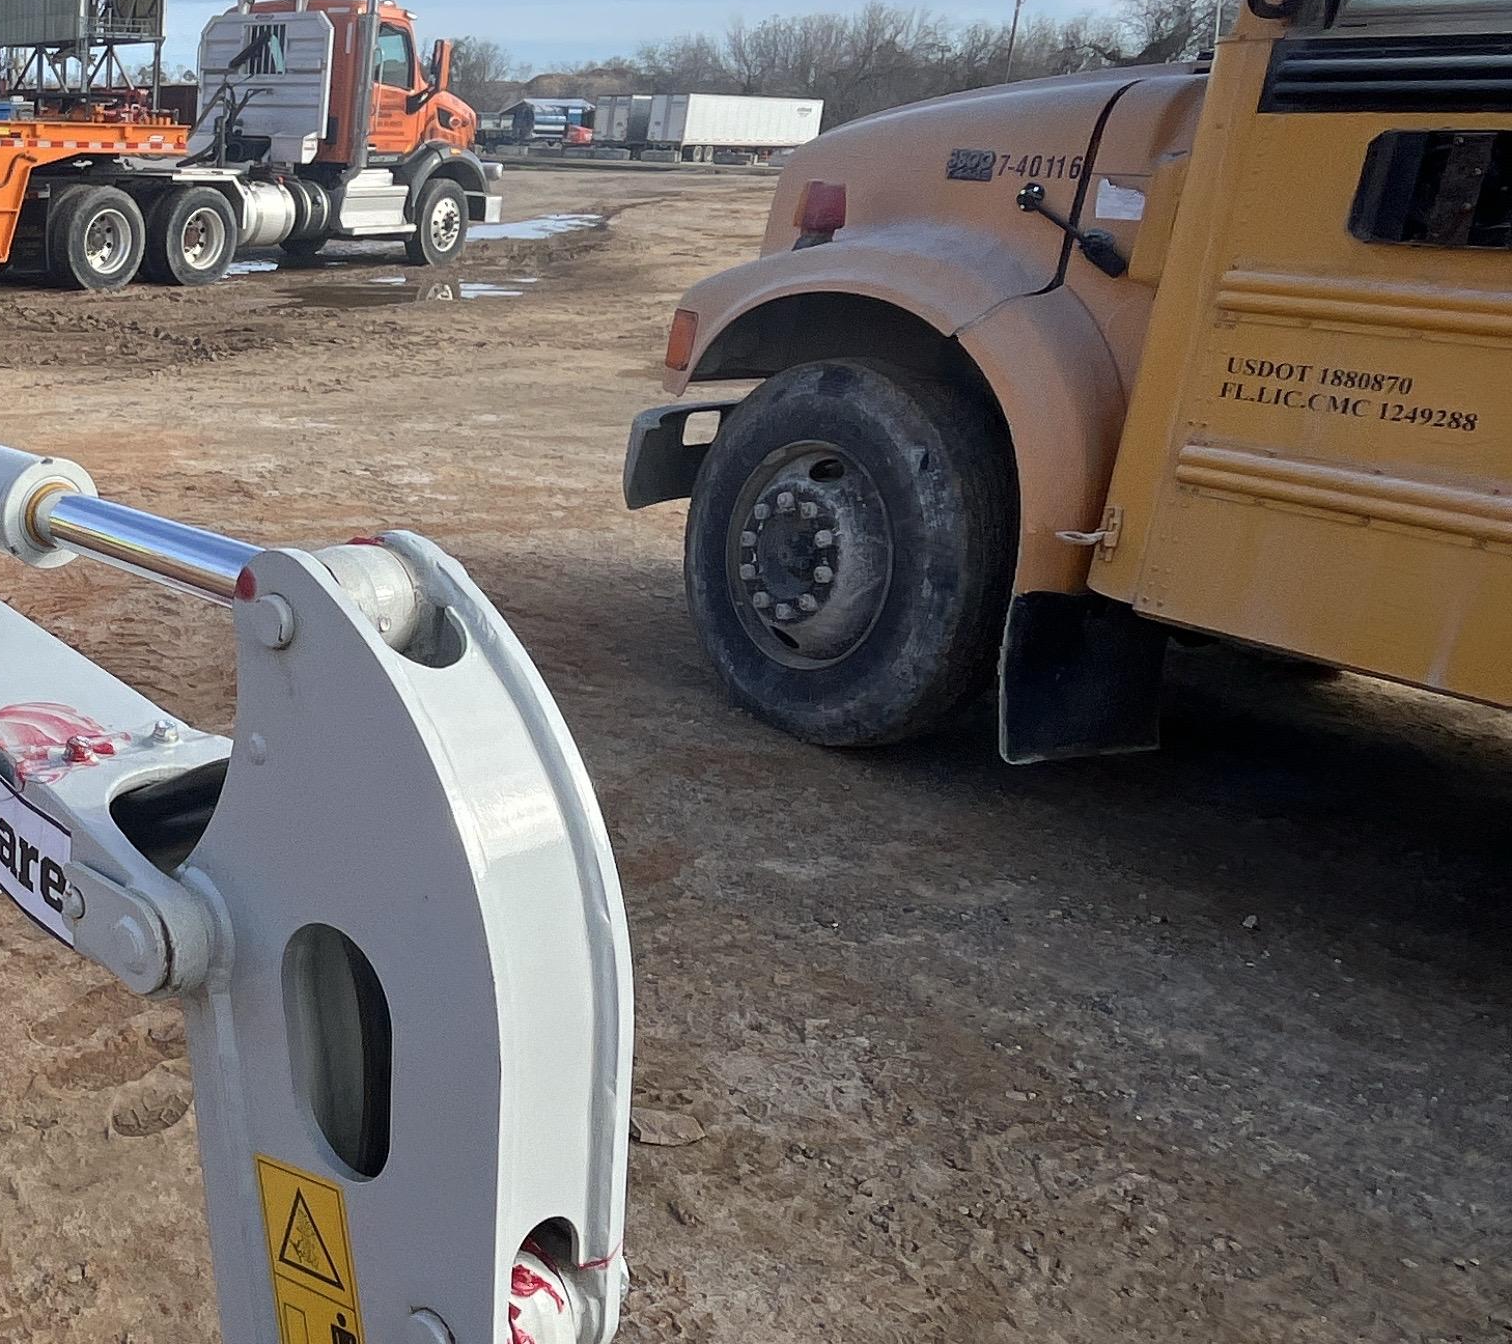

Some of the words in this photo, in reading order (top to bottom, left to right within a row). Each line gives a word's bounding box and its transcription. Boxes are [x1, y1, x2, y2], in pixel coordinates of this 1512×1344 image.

[998, 154, 1085, 180] 7-40116
[1227, 356, 1314, 383] USDOT
[1319, 367, 1414, 396] 1880870
[1378, 402, 1479, 433] 1249288
